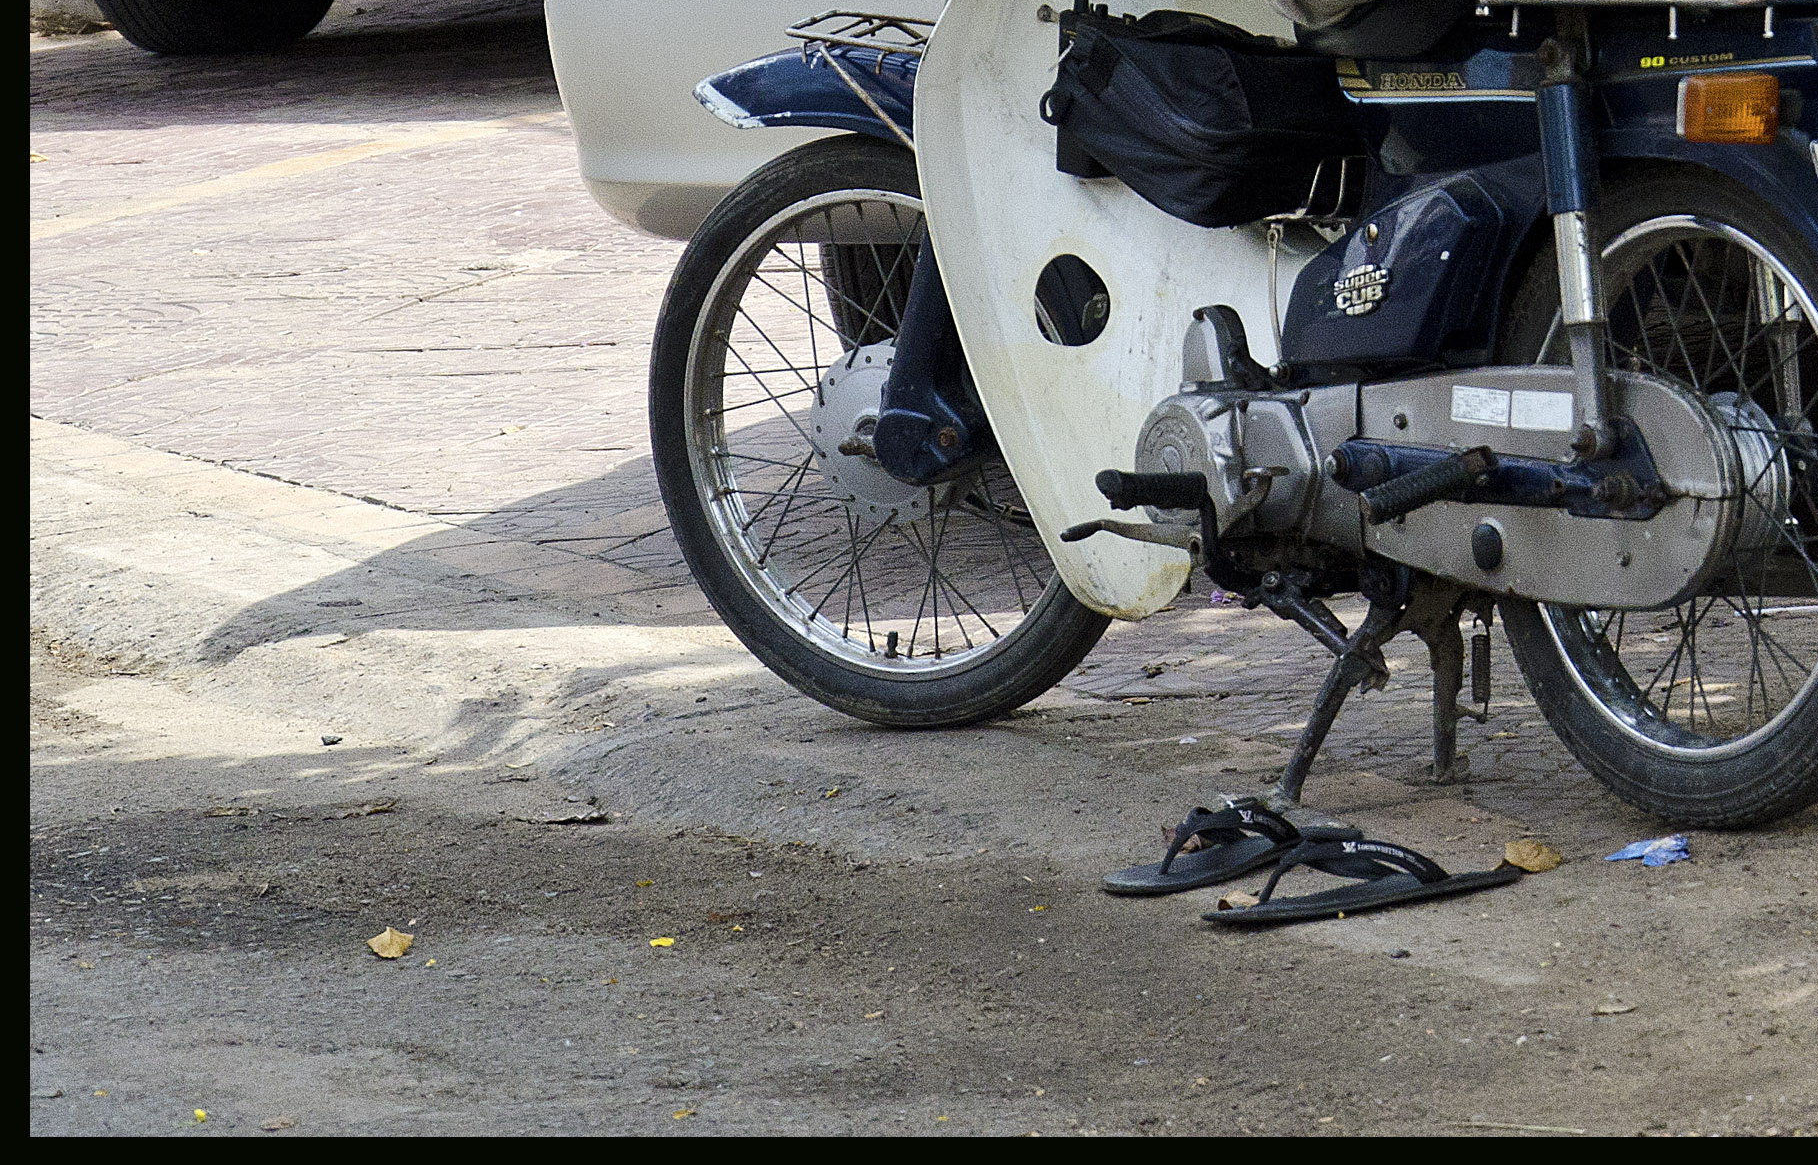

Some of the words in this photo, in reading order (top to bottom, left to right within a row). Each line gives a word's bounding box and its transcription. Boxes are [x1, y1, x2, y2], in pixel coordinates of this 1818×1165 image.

[1640, 55, 1666, 68] 90
[1669, 52, 1734, 65] CUSTOM
[1380, 72, 1466, 91] HONDA
[1335, 284, 1384, 310] CUB
